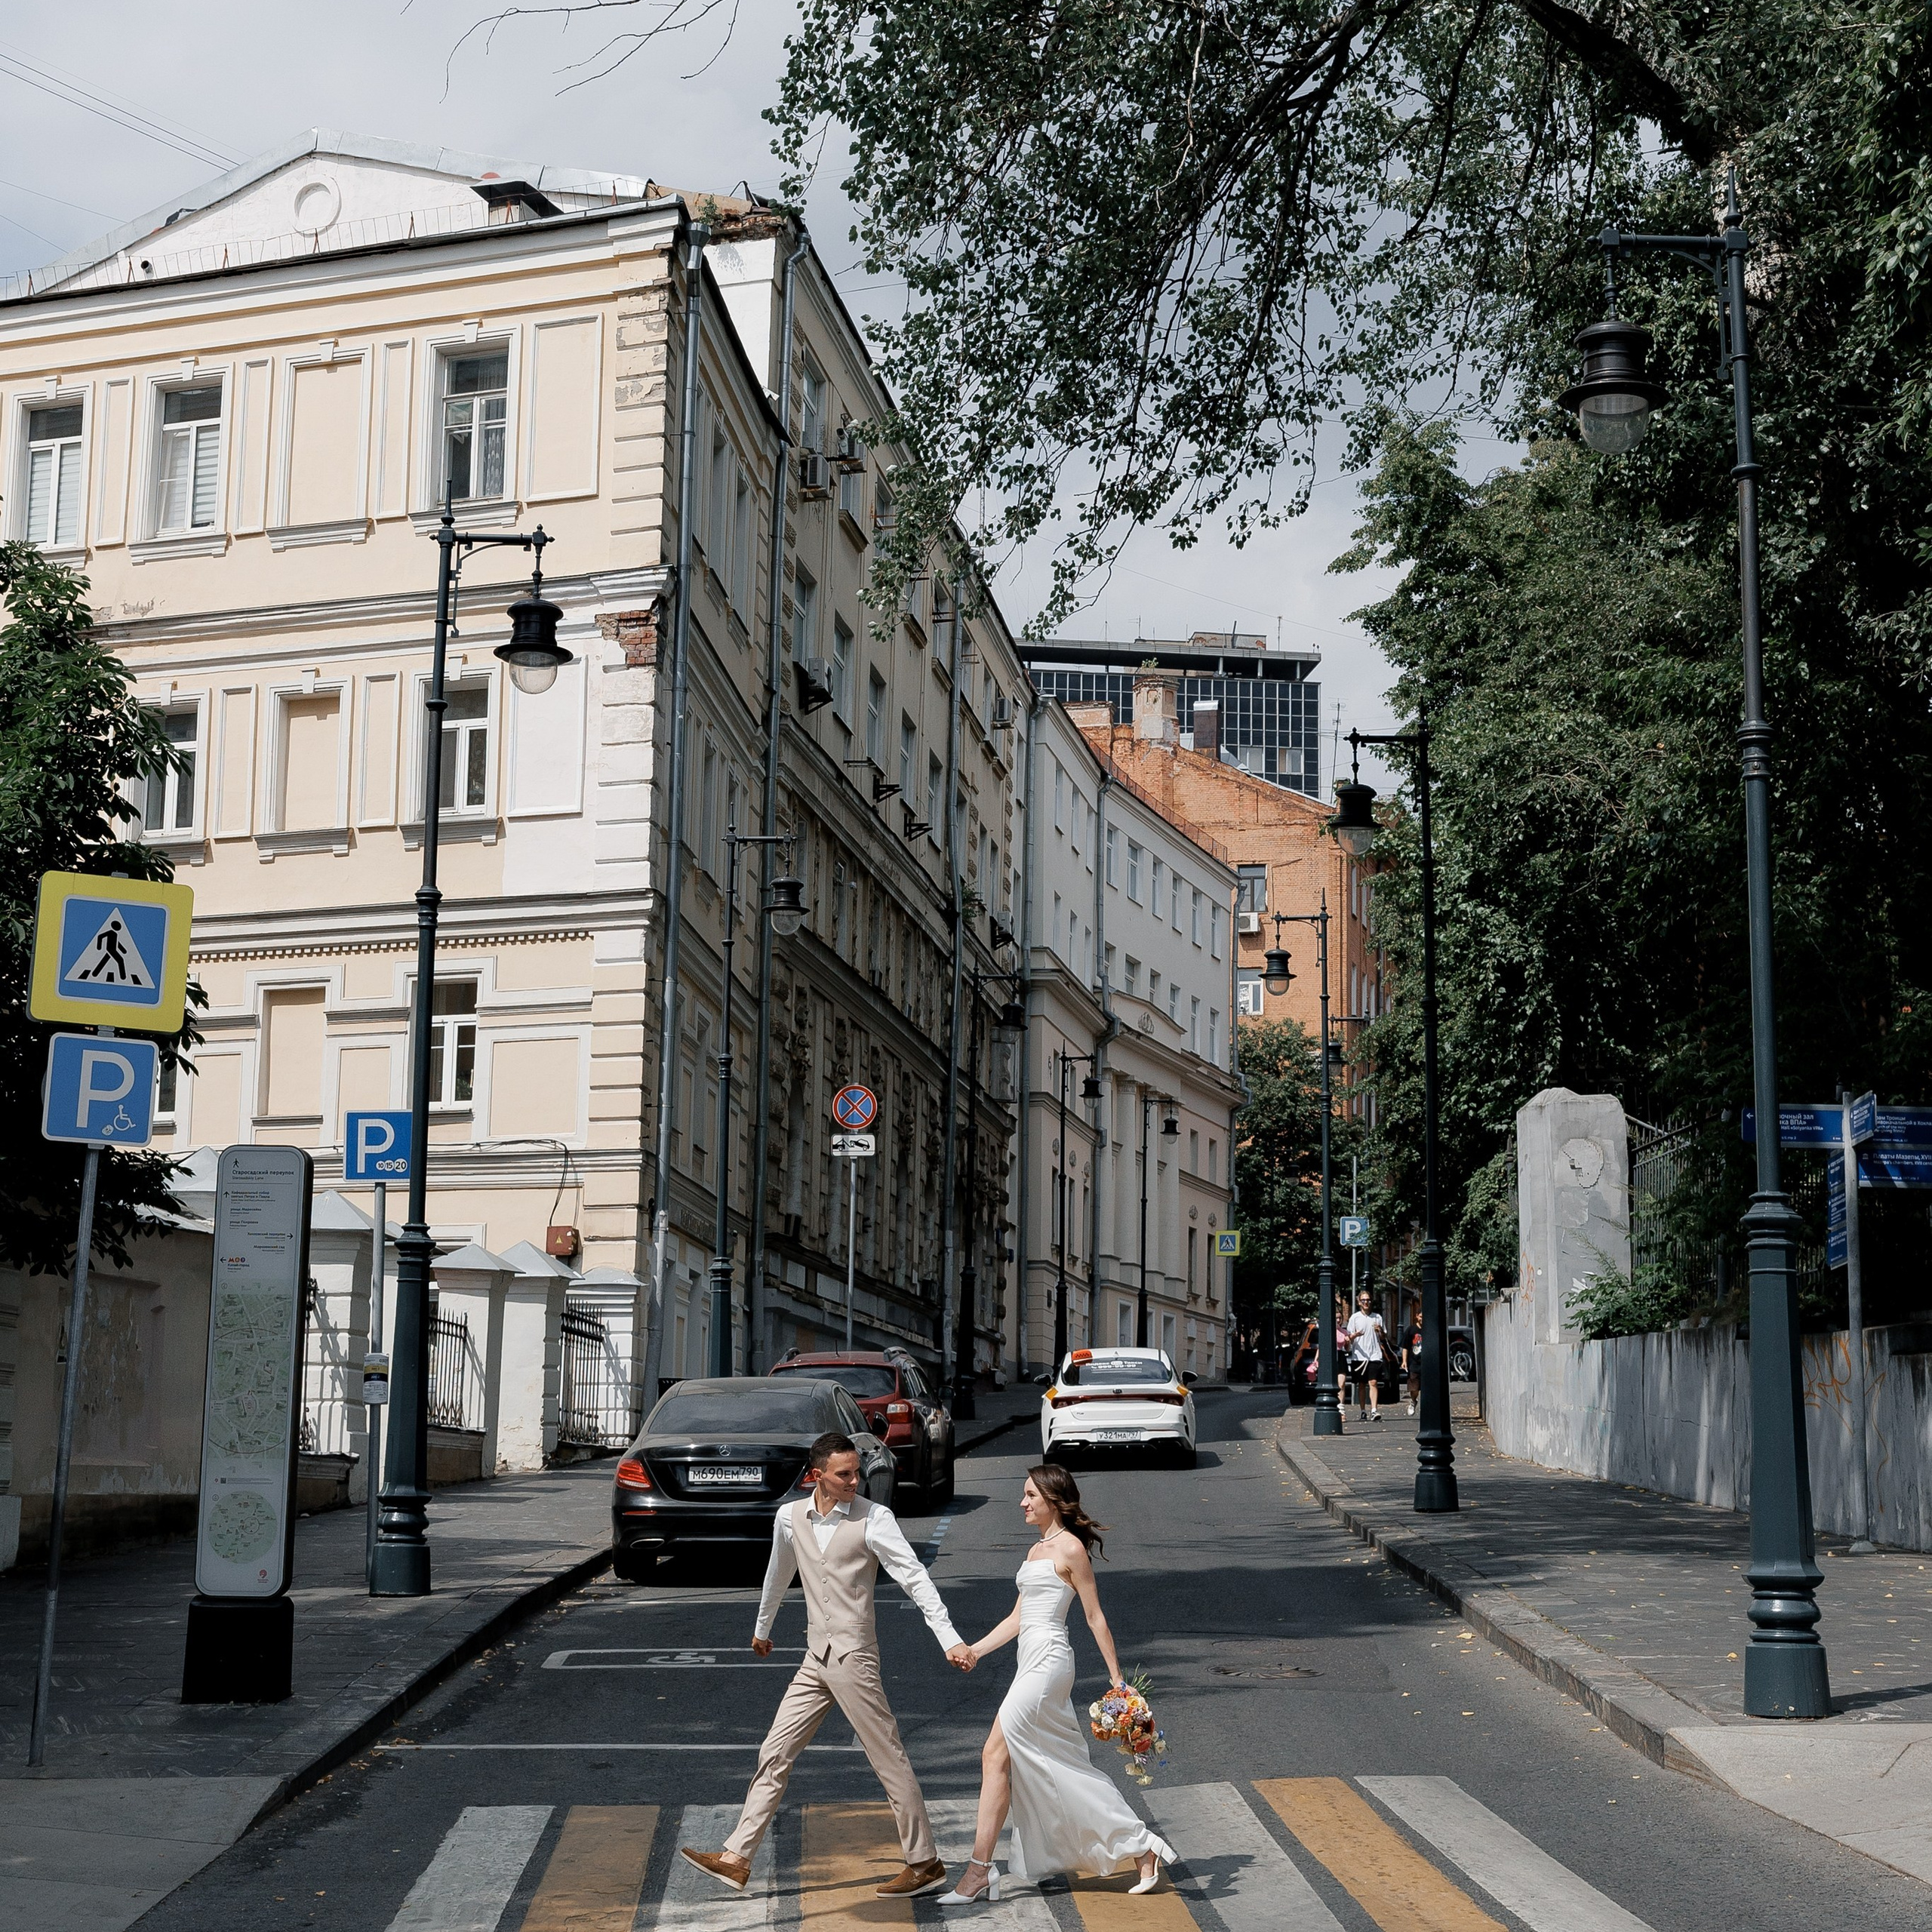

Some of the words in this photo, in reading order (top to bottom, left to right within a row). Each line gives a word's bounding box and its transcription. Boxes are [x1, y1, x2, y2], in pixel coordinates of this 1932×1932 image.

[75, 1049, 135, 1128] P
[357, 1118, 395, 1173] P
[395, 1161, 407, 1170] 20
[1345, 1220, 1361, 1241] P
[693, 1467, 739, 1479] М690ЕМ
[740, 1467, 758, 1476] 790
